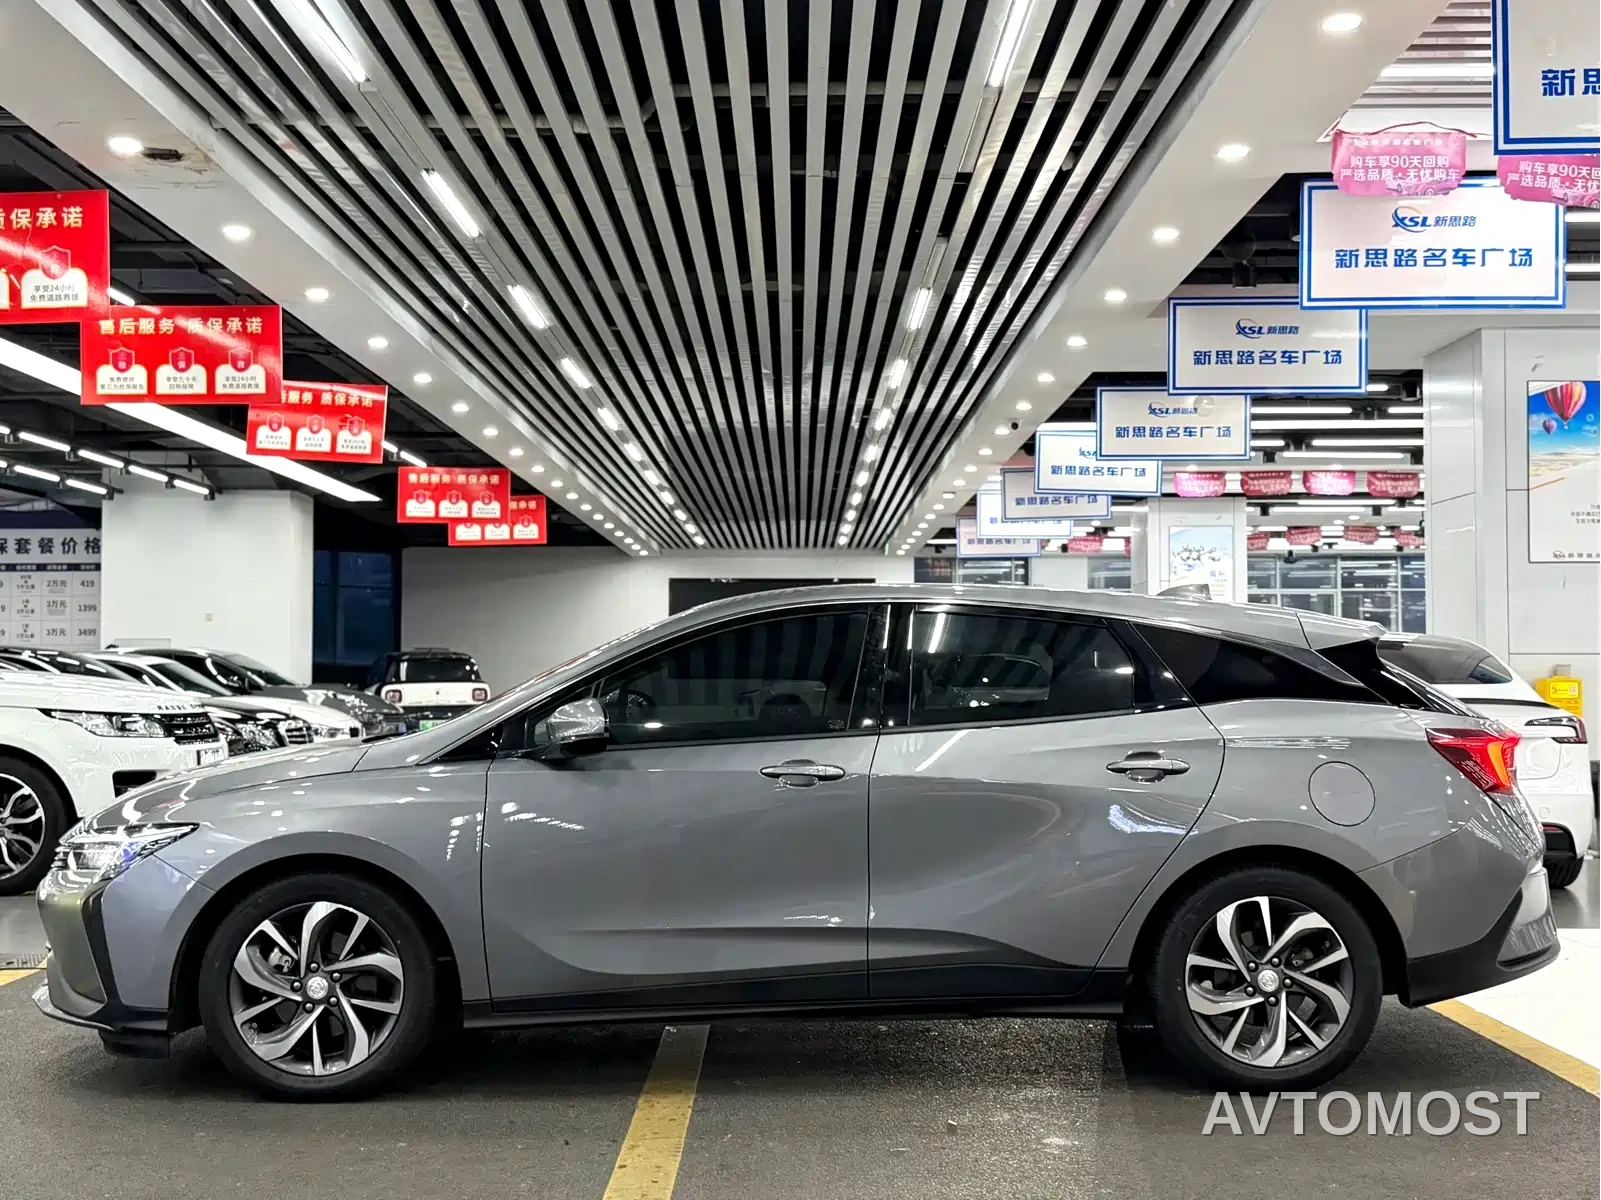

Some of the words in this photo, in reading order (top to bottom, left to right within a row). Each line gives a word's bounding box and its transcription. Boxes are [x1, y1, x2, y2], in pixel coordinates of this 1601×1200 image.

[1350, 156, 1449, 168] 购车享90天回购
[0, 206, 83, 229] 保承诺
[1433, 215, 1477, 228] 新思路
[1335, 248, 1533, 268] 新思路名车广场
[99, 318, 174, 335] 售后服务
[187, 317, 262, 335] 质保承诺
[1266, 326, 1299, 335] 新思路
[1193, 350, 1342, 366] 新思路名车广场
[1115, 426, 1231, 438] 新思路名车广场
[1050, 464, 1146, 477] 新思路名车广场
[1015, 495, 1098, 506] 新思路名车广场
[80, 580, 95, 588] 419
[77, 604, 97, 612] 1399
[77, 628, 97, 636] 3499
